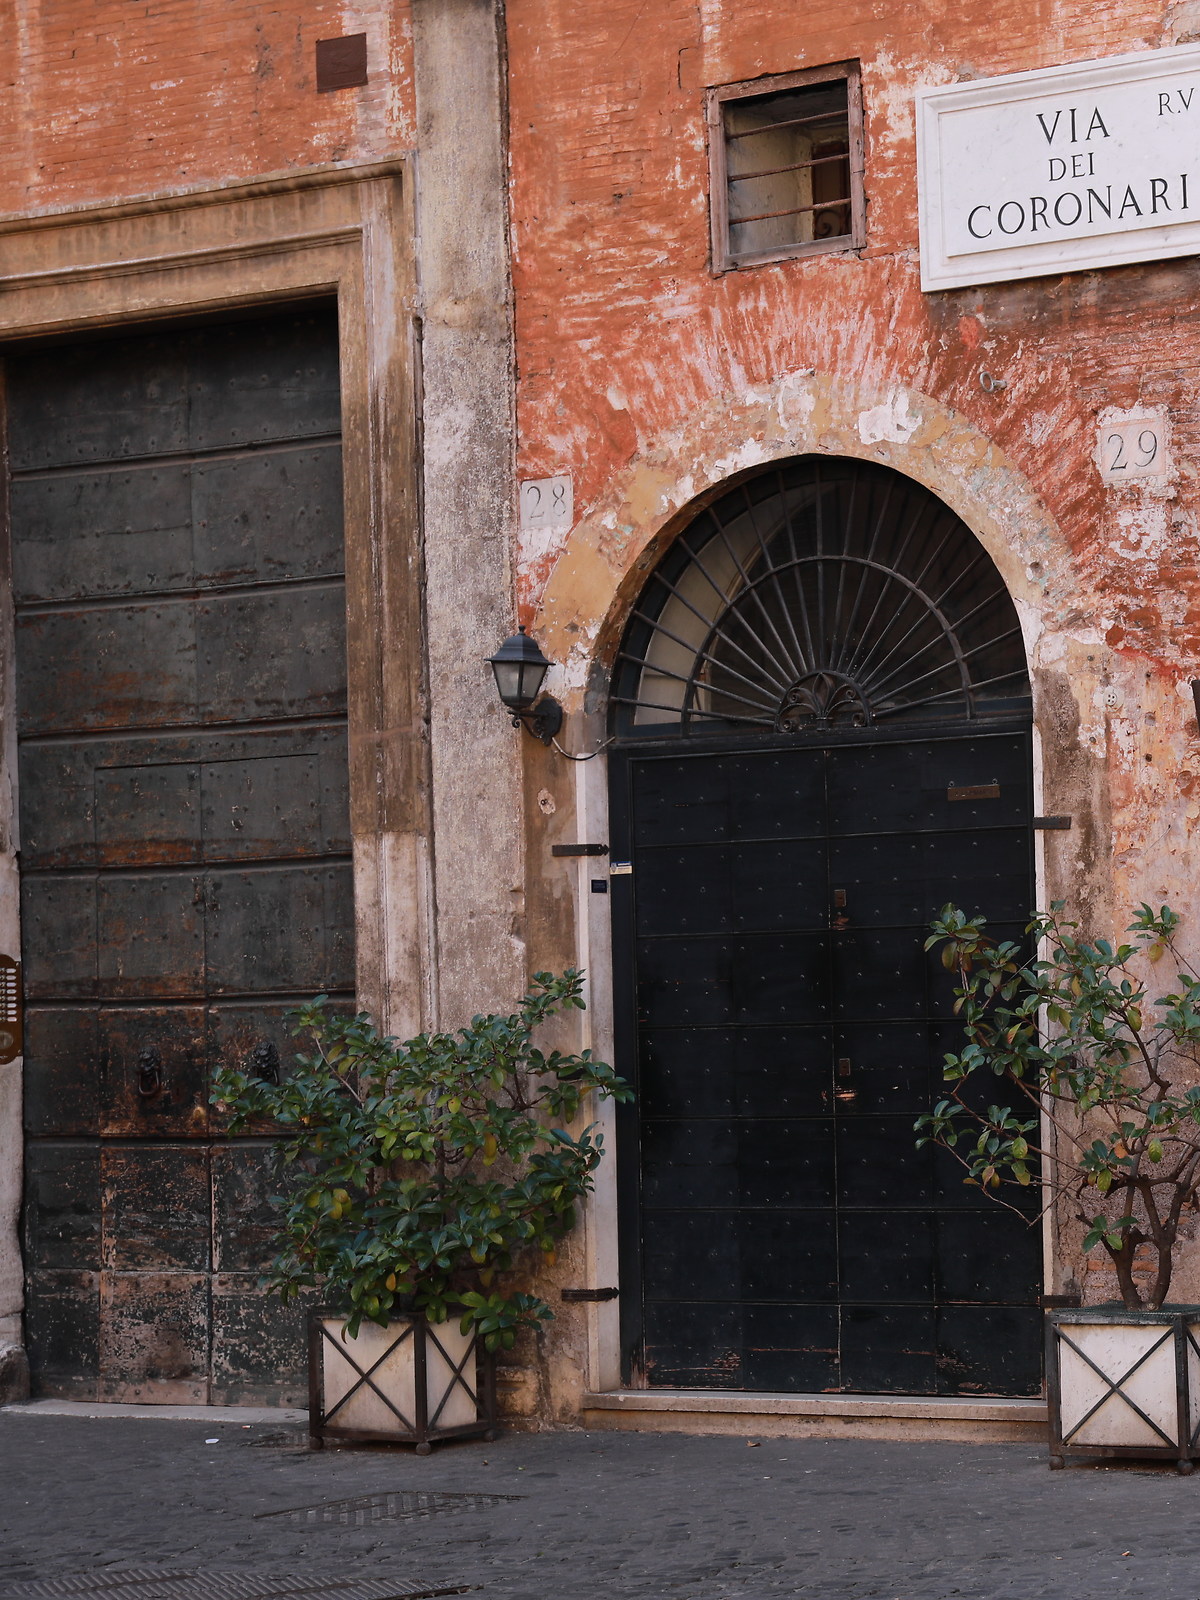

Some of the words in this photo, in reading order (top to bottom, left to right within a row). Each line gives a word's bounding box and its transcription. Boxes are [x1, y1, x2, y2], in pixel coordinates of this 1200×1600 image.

[1036, 106, 1110, 145] VIA
[1048, 152, 1095, 182] DEI
[967, 173, 1189, 239] CORONARI
[1107, 430, 1158, 471] 29
[527, 484, 566, 520] 28
